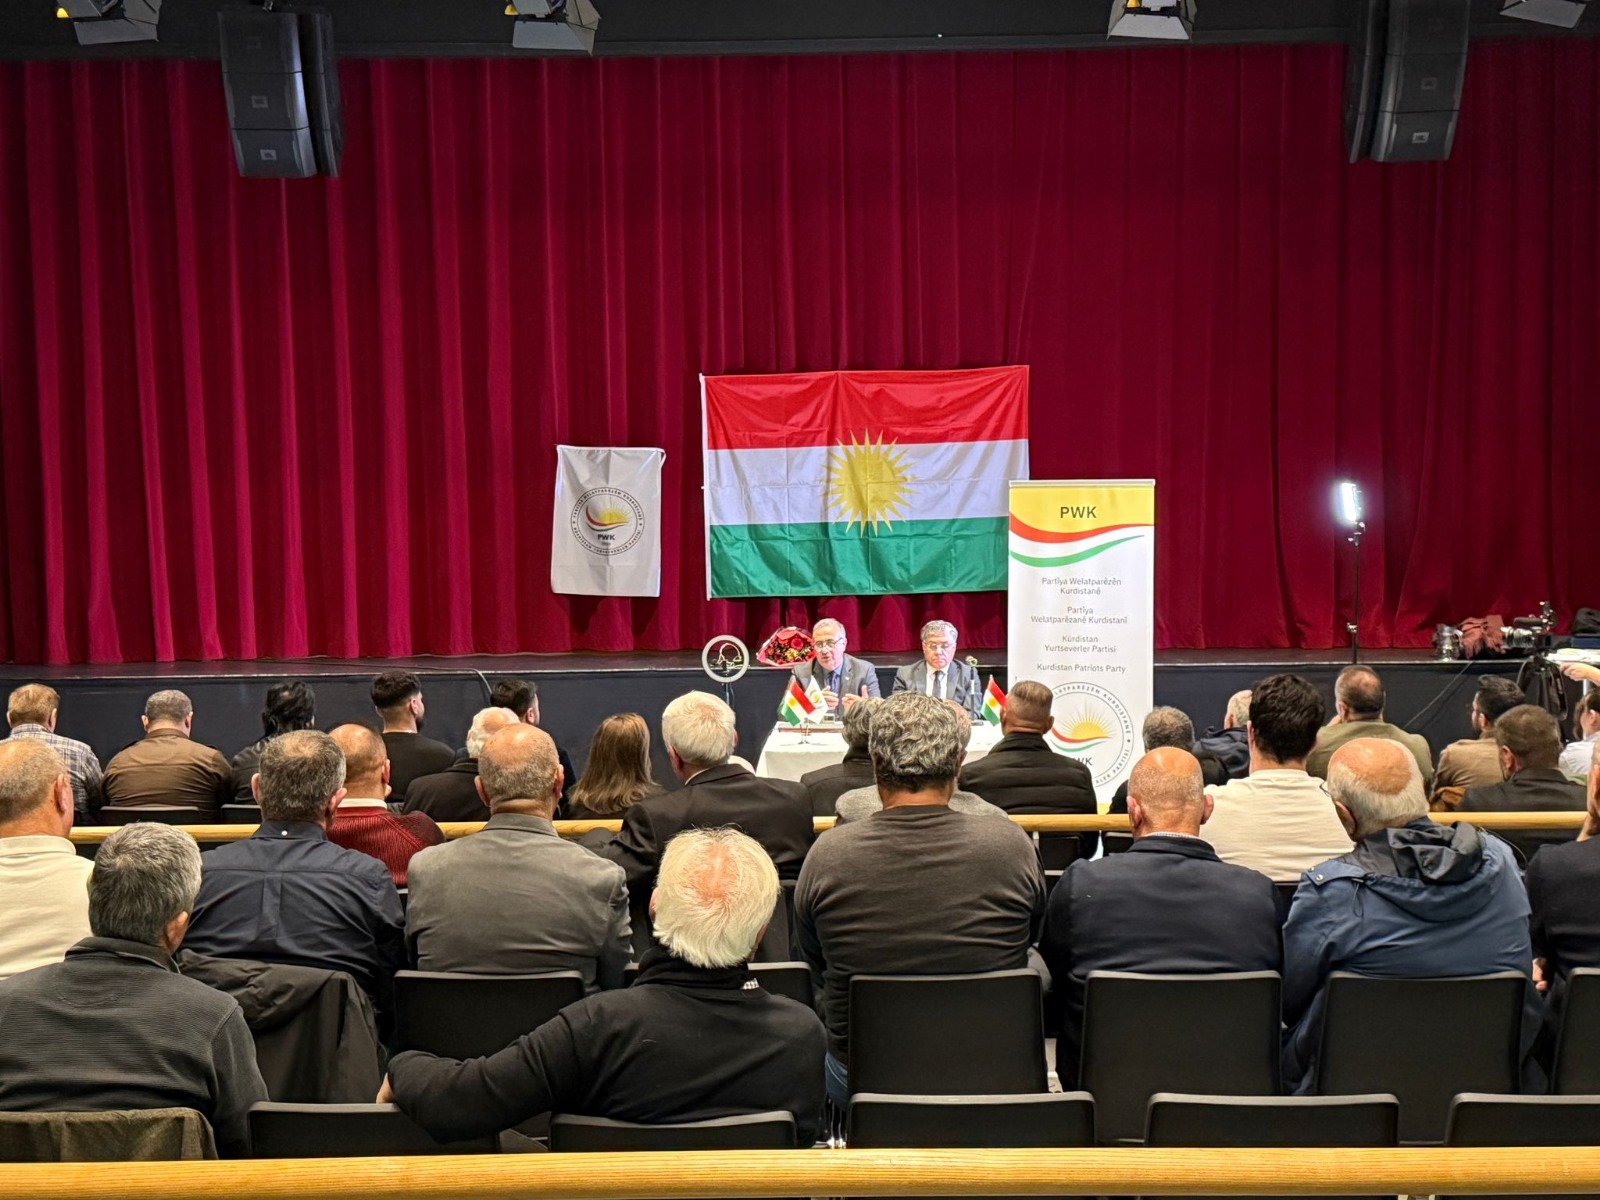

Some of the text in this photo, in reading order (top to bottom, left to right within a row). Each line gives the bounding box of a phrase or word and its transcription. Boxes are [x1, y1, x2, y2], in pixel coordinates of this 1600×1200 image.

[1060, 506, 1097, 519] PWK
[1044, 644, 1117, 654] Yurtseverler Partisi
[1037, 662, 1126, 675] Kurdistan Patriots Party
